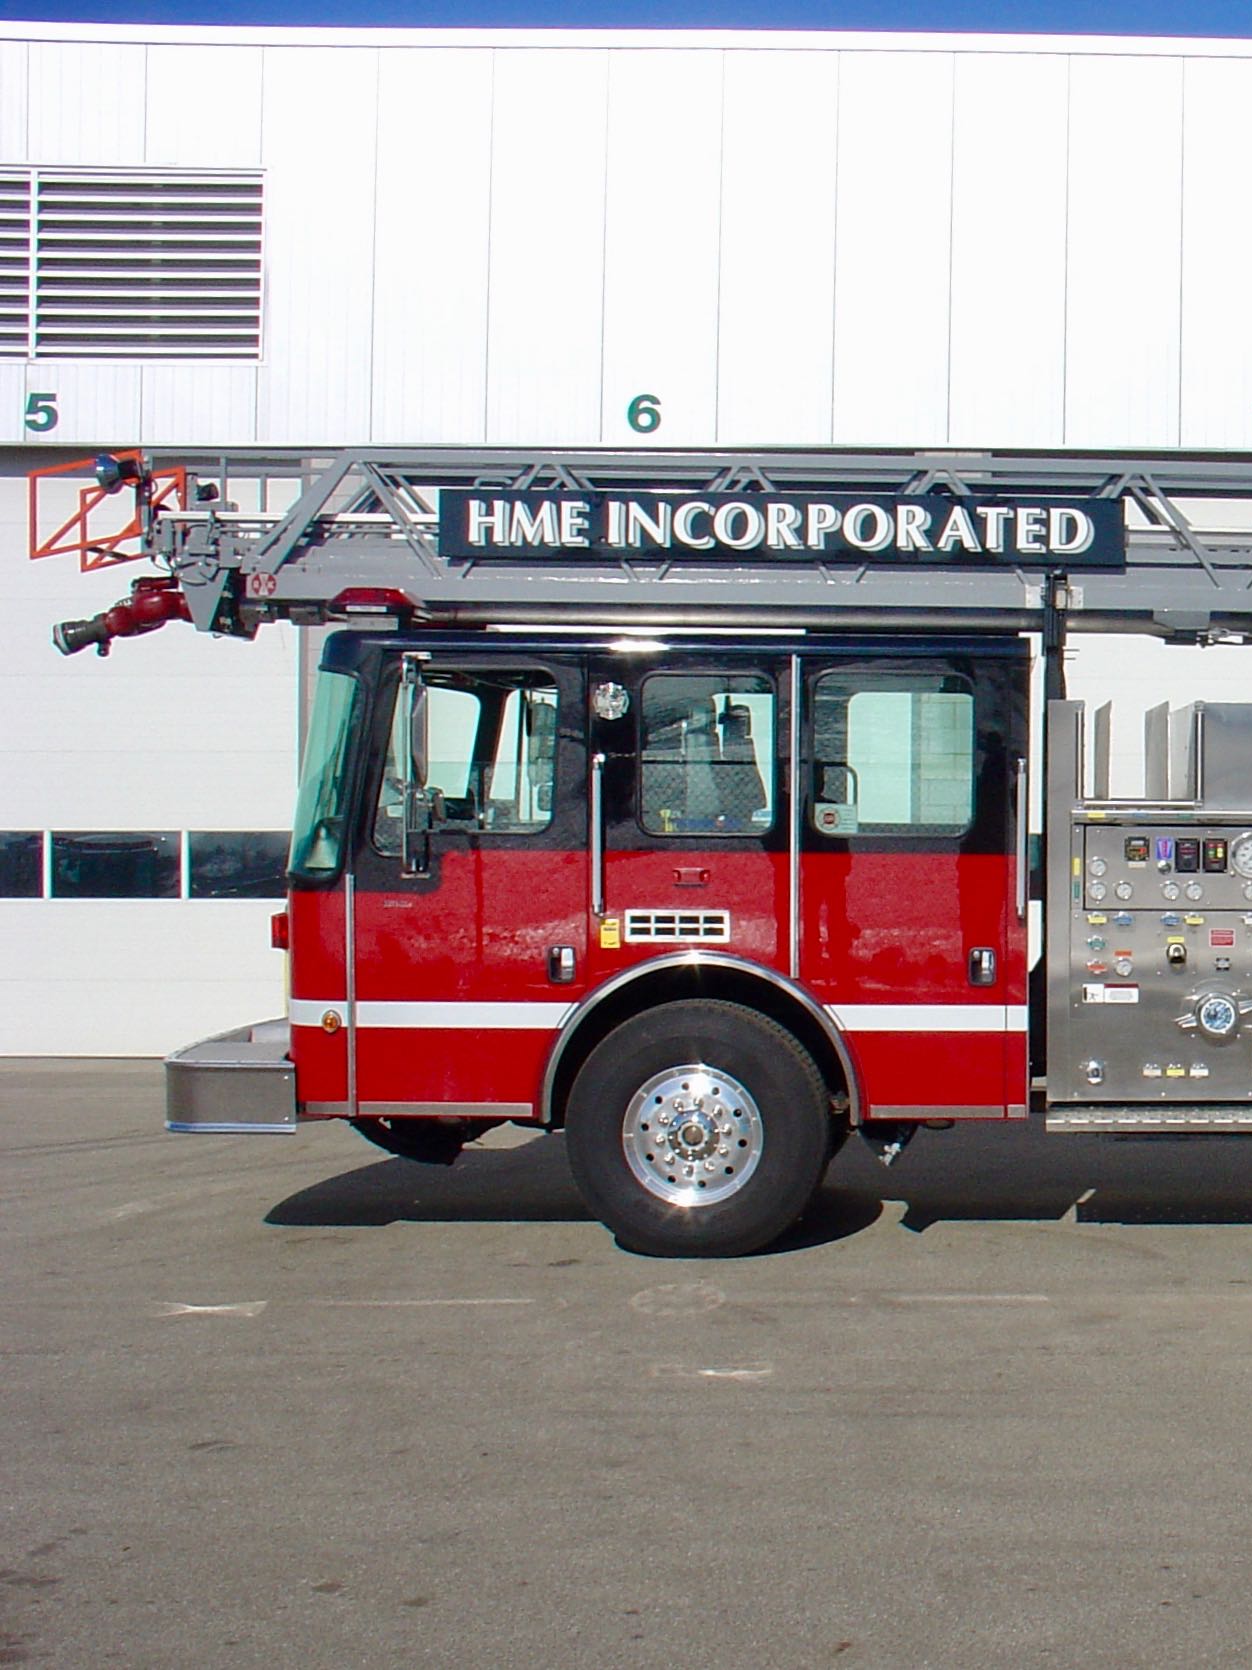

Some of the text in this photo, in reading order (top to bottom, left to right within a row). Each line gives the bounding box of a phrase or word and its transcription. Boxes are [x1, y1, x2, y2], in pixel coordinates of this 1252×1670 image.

[25, 393, 58, 432] 5
[628, 394, 661, 433] 6
[467, 499, 1095, 554] HME INCORPORATED
